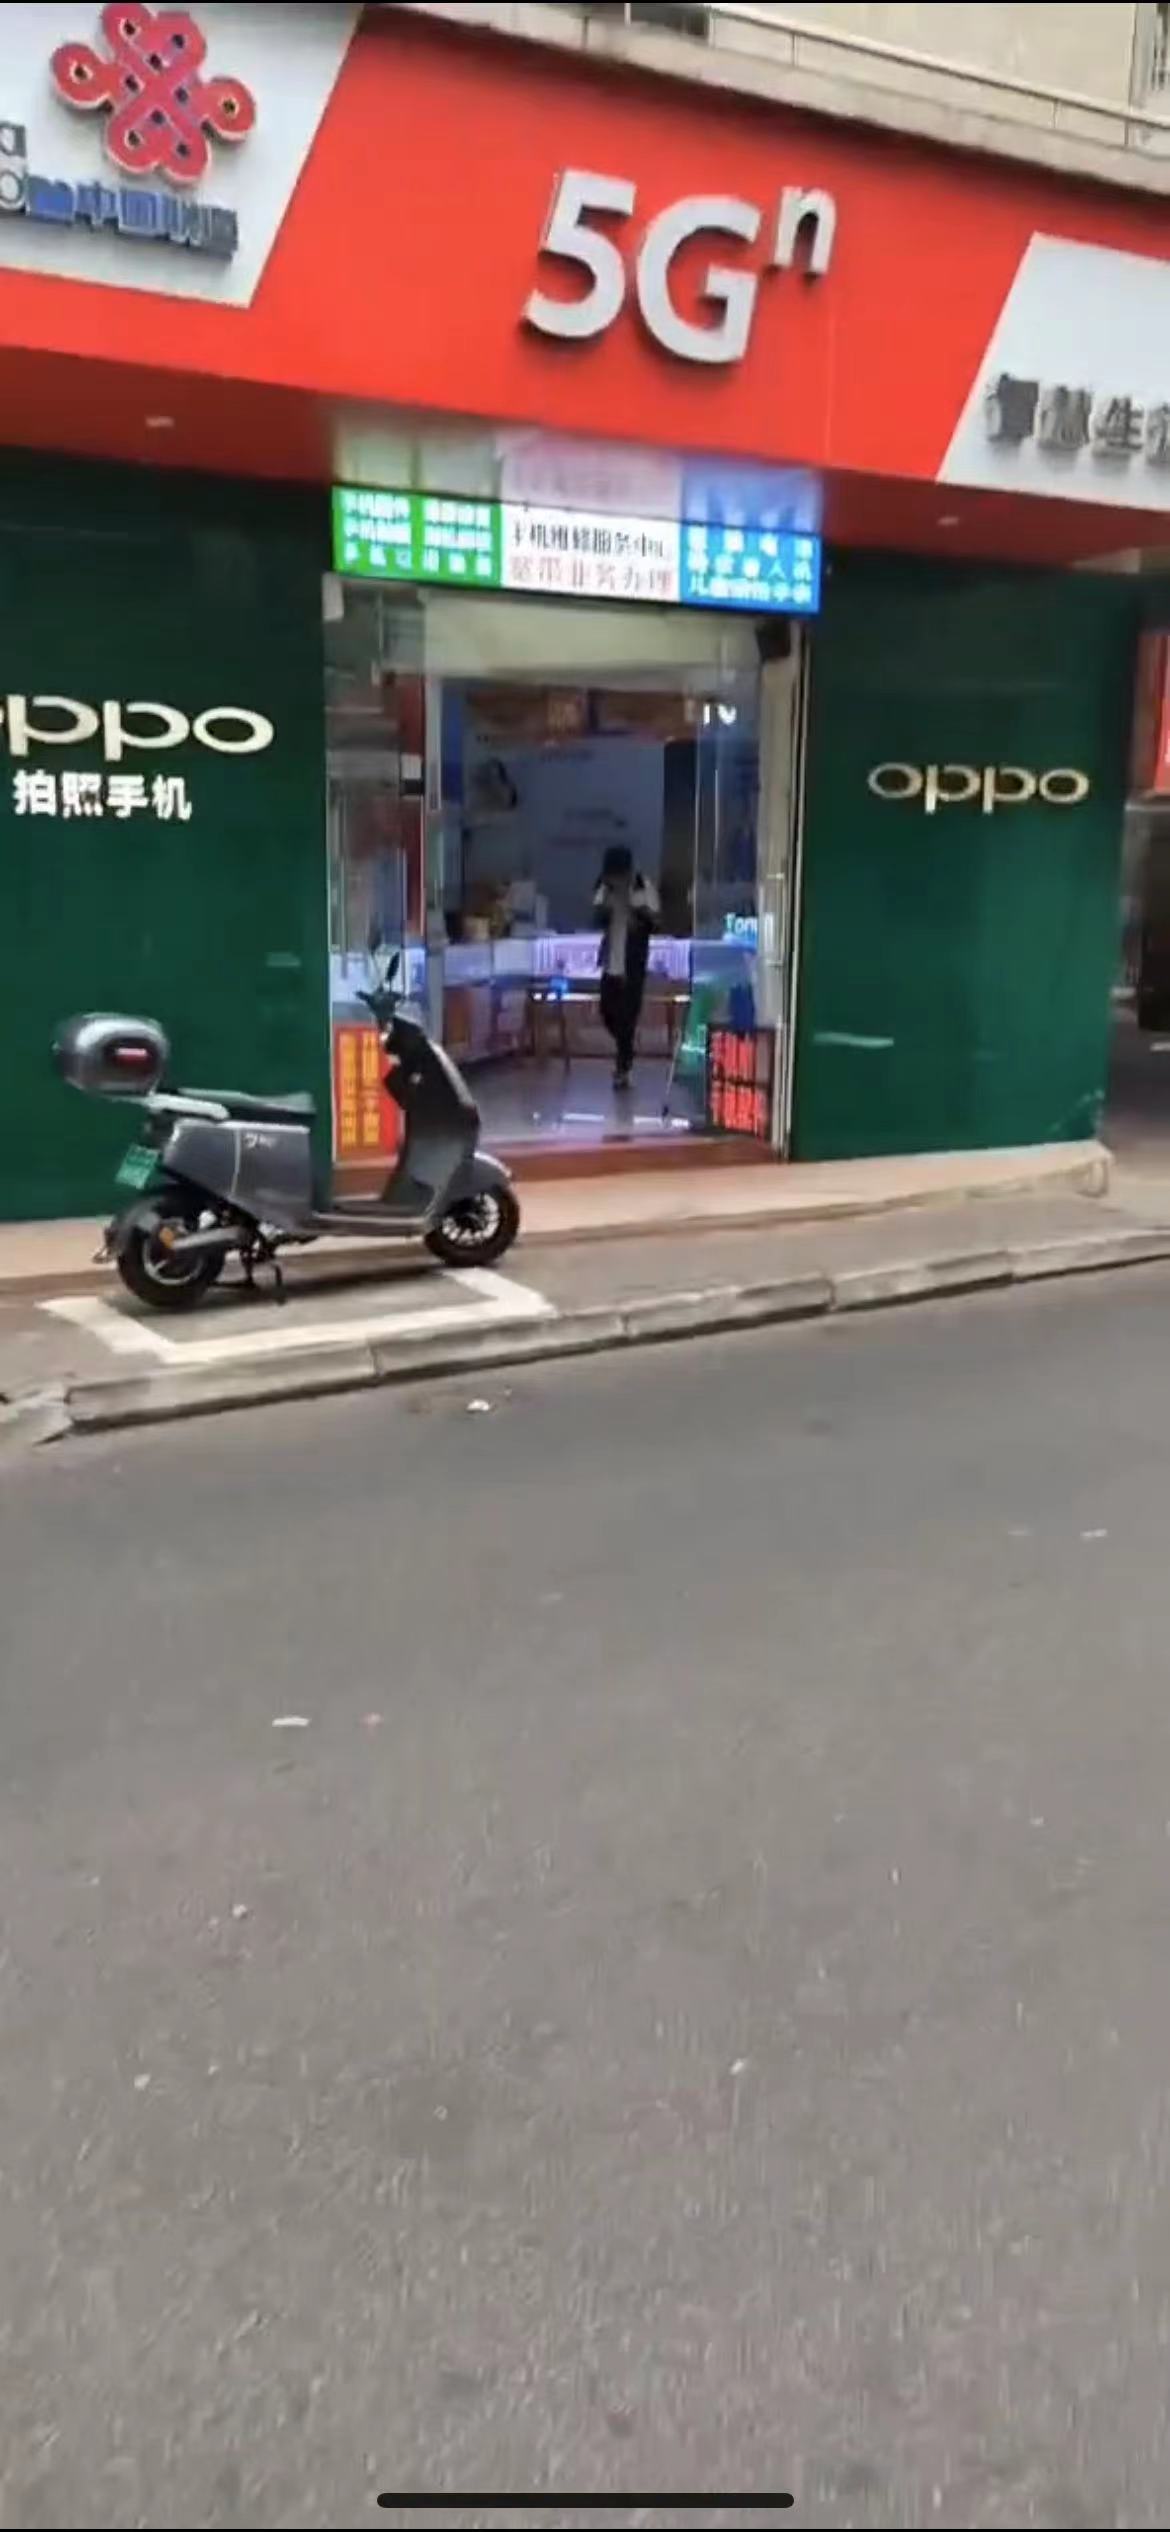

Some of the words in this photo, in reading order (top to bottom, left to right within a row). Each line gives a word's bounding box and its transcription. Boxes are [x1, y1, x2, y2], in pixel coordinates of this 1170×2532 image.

[0, 694, 274, 761] ppo
[13, 769, 192, 820] 拍照手机
